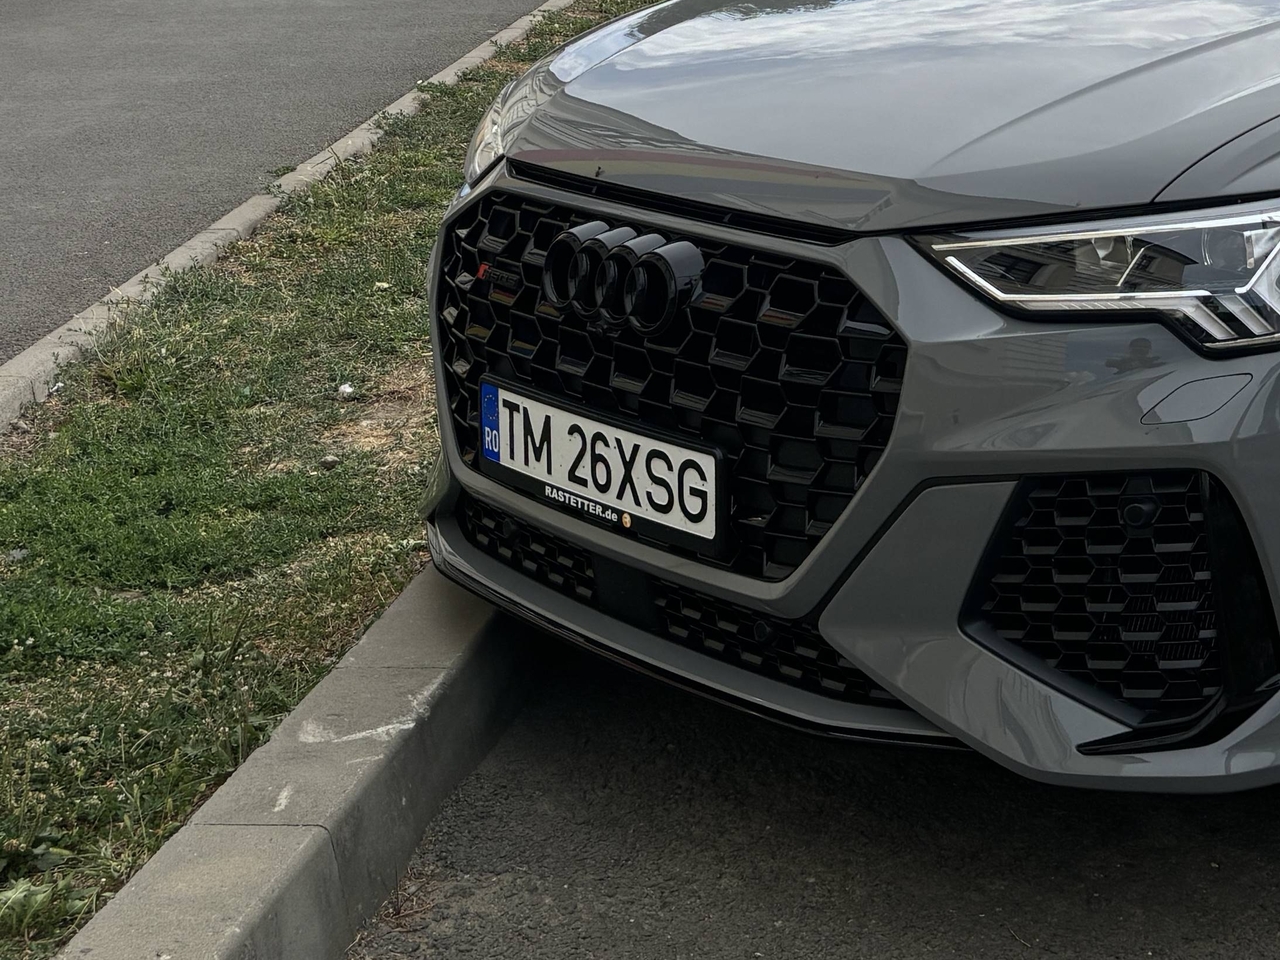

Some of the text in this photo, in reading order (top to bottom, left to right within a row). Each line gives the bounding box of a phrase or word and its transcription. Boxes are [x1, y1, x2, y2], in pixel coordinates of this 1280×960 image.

[484, 426, 499, 452] RO
[502, 398, 710, 523] TM 26XSG
[545, 485, 618, 522] RASTETTER.de
